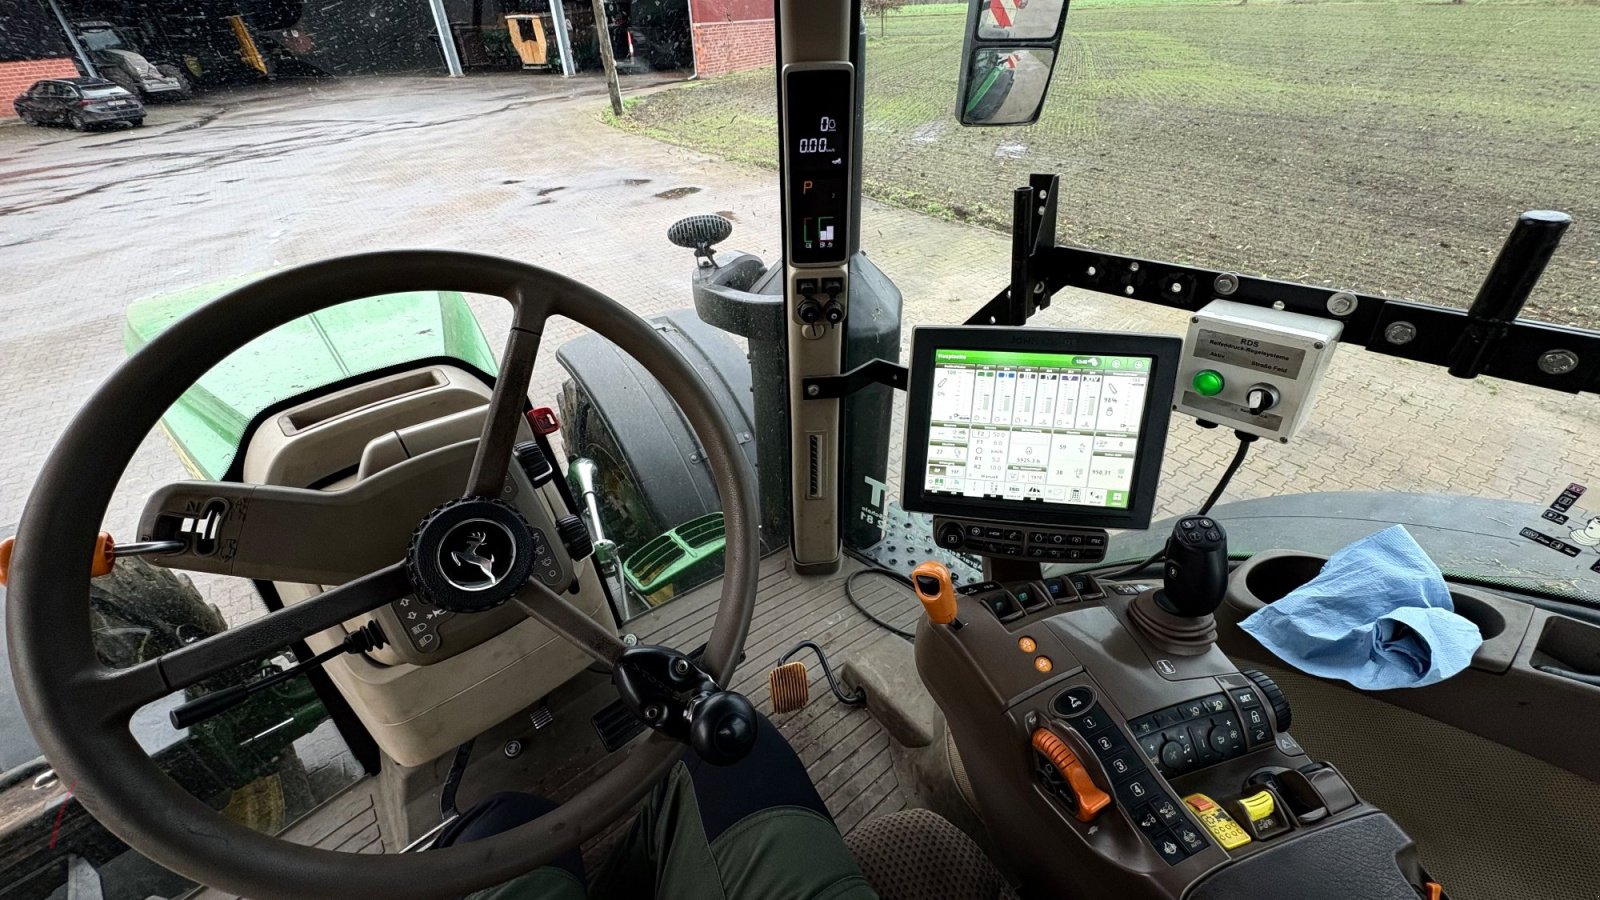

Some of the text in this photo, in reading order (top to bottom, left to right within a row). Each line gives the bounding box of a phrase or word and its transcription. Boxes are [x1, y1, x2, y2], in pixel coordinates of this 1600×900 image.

[799, 138, 827, 153] 0.00
[803, 181, 813, 194] P
[1240, 338, 1259, 347] RDS
[1209, 339, 1289, 361] Reifendruck-Regelsysteme
[1239, 694, 1252, 702] SET
